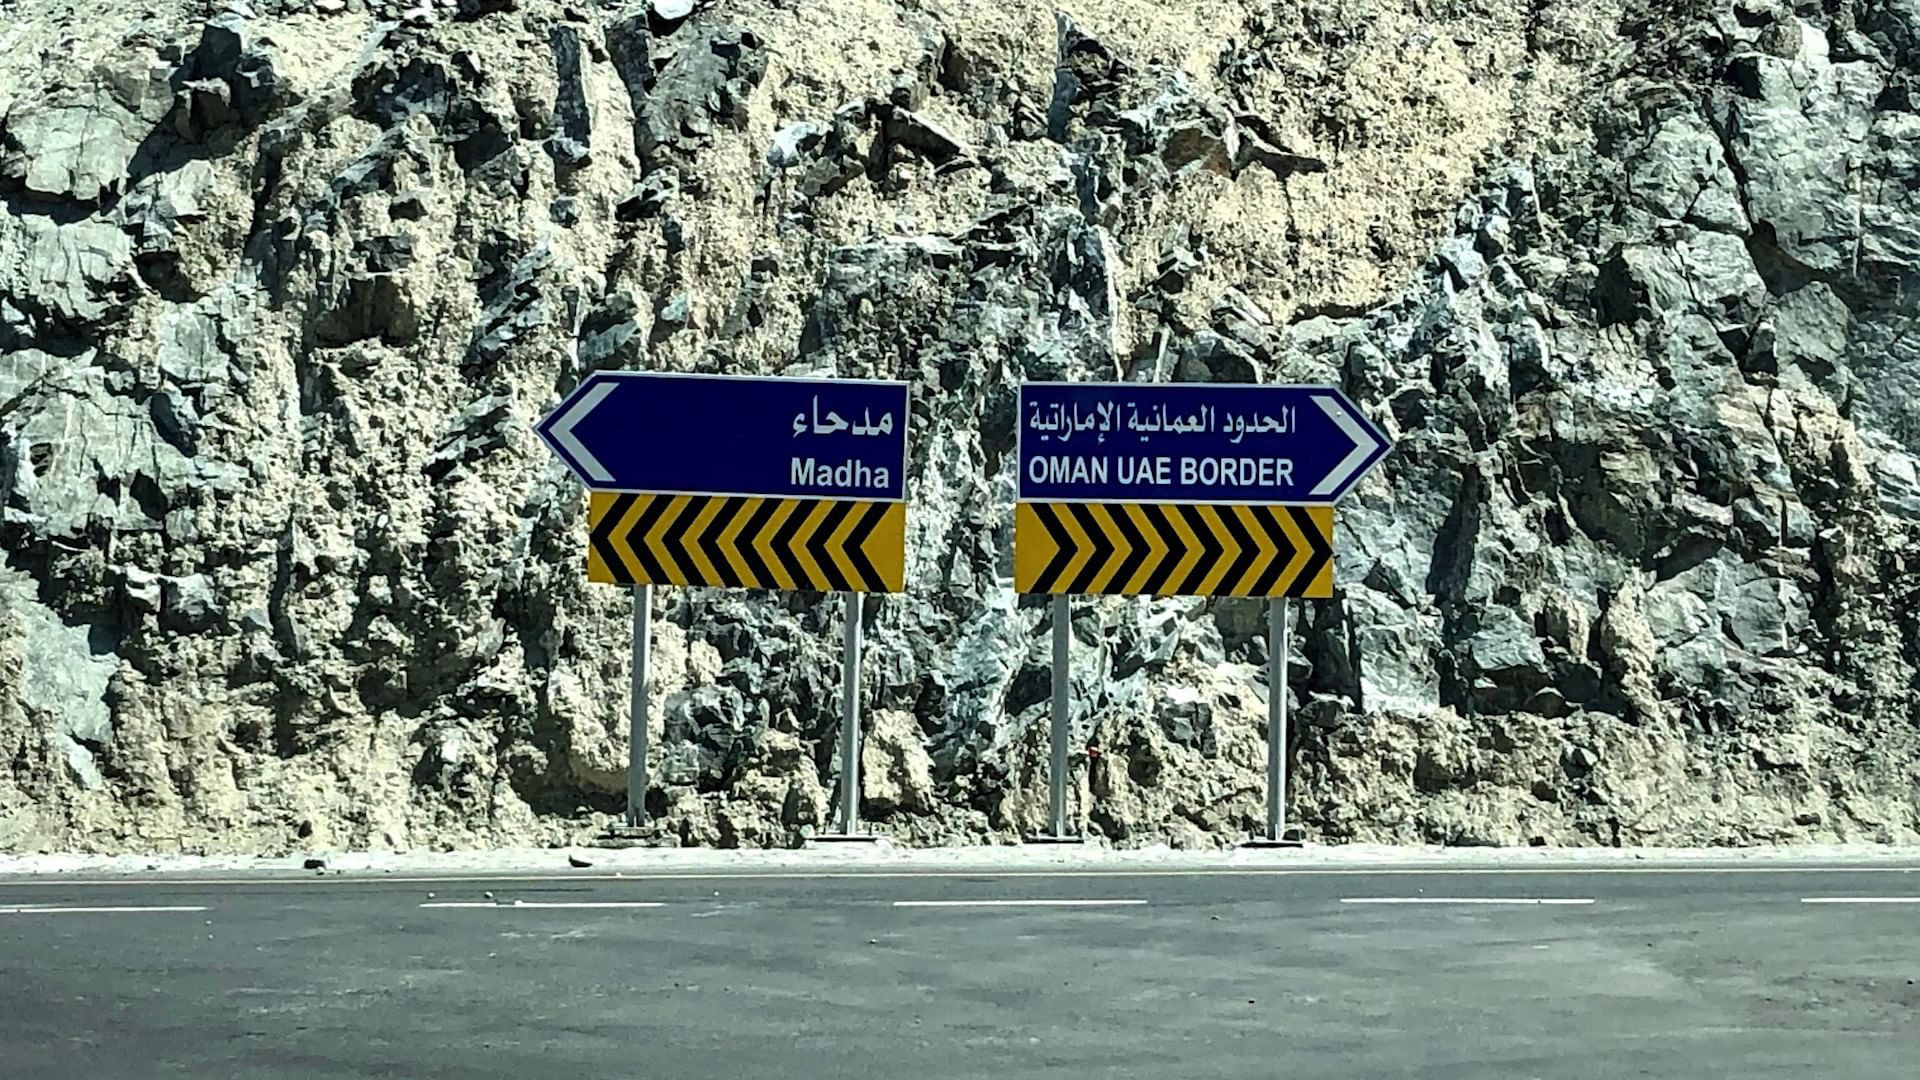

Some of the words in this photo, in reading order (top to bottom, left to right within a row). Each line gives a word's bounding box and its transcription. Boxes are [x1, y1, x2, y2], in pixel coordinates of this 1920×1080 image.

[792, 394, 893, 438] مدحاء
[1029, 401, 1121, 444] الإماراتية
[1127, 402, 1215, 442] العمانية
[1223, 405, 1296, 443] الحدود
[791, 457, 889, 488] Madha
[1029, 455, 1108, 484] OMAN
[1117, 456, 1171, 485] UAE
[1180, 457, 1294, 486] BORDER
